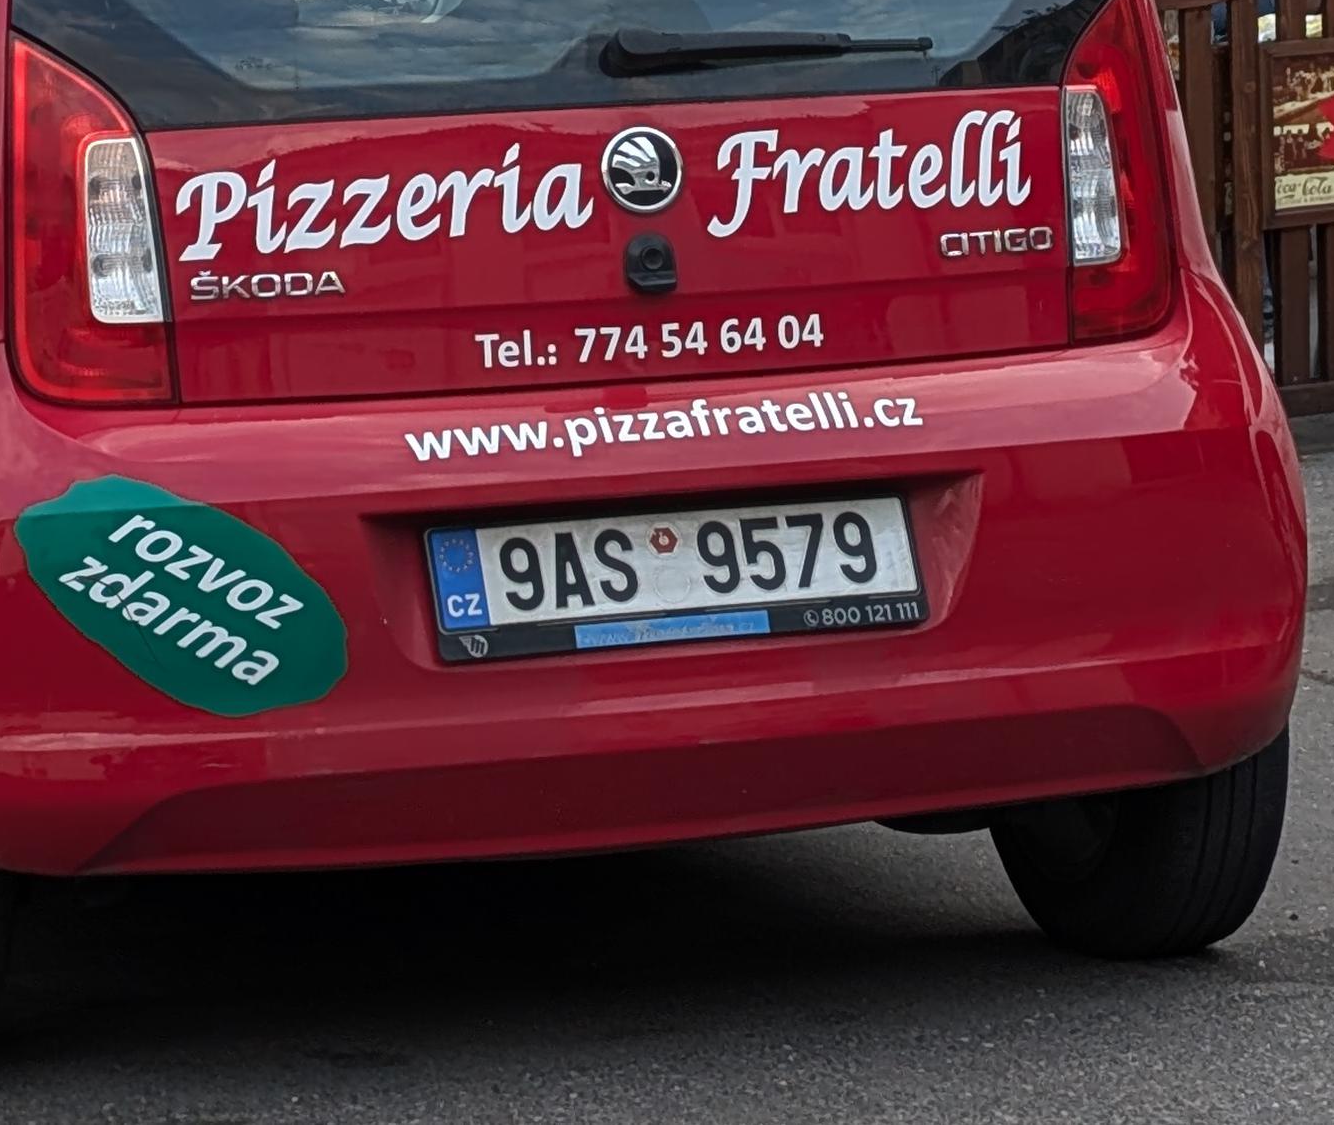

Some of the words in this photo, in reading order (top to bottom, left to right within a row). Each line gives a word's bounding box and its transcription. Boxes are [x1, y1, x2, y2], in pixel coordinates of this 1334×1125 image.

[176, 142, 595, 263] Pizzeria
[707, 110, 1032, 238] Fratelli
[940, 226, 1054, 257] CITIGO
[189, 270, 346, 302] ŠKODA
[475, 330, 558, 370] Tel.:
[574, 325, 649, 364] 774
[660, 321, 709, 358] 54
[719, 316, 767, 355] 64
[777, 312, 825, 351] 04
[404, 390, 924, 463] www.pizzafratelli.cz
[108, 513, 304, 630] rozvoz
[497, 527, 640, 612] 9AS
[696, 511, 879, 595] 9579
[58, 555, 280, 686] zdarma
[446, 593, 483, 619] CZ
[821, 607, 861, 626] 800
[864, 603, 893, 623] 121
[896, 601, 920, 620] 111
